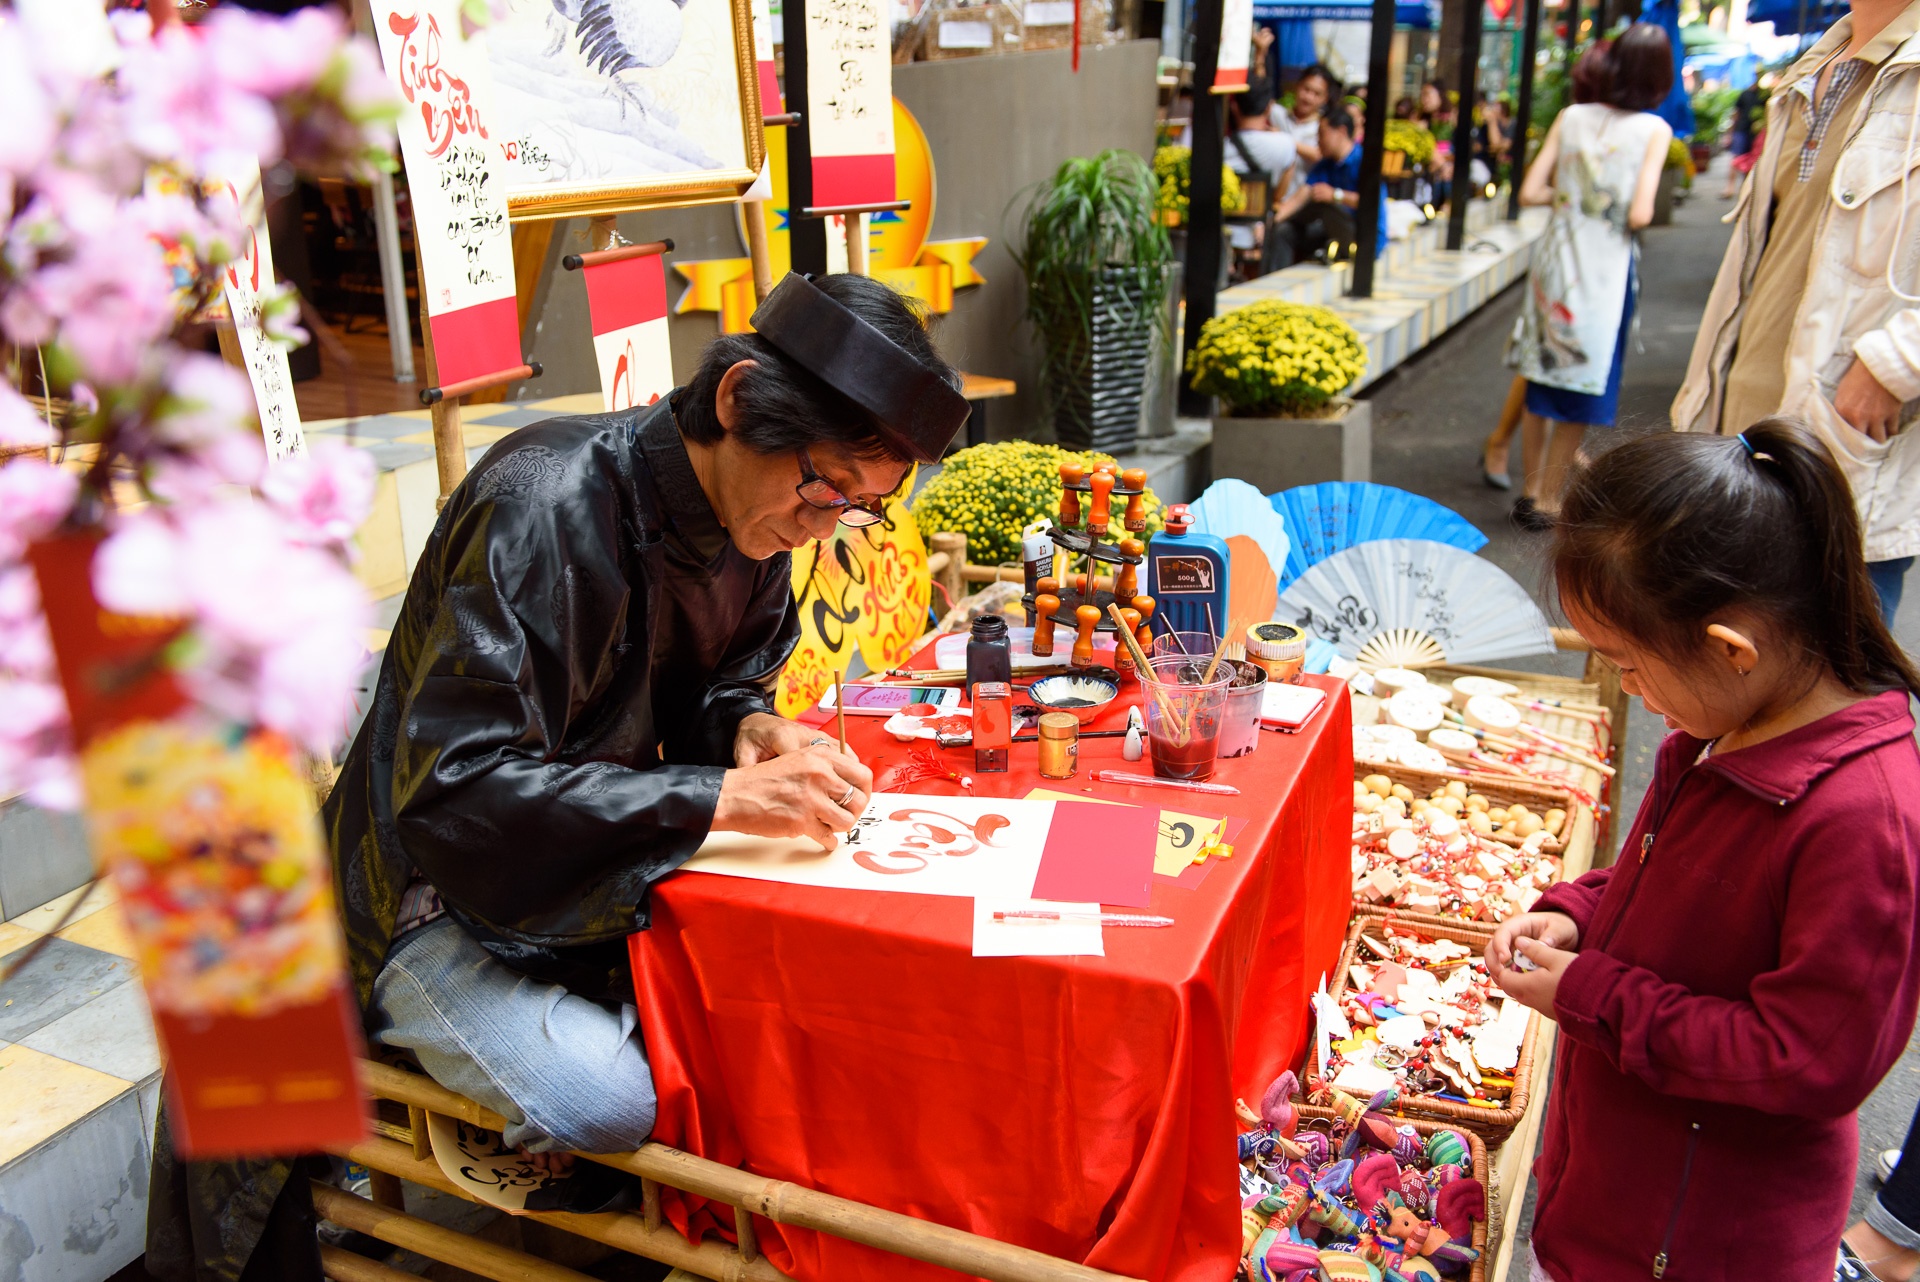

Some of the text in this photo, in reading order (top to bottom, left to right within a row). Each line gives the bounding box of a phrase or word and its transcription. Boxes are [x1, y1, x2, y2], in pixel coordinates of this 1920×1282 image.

[1036, 557, 1052, 566] SAKURA
[1036, 563, 1053, 572] ACRYLIC
[1037, 569, 1051, 578] COLOR
